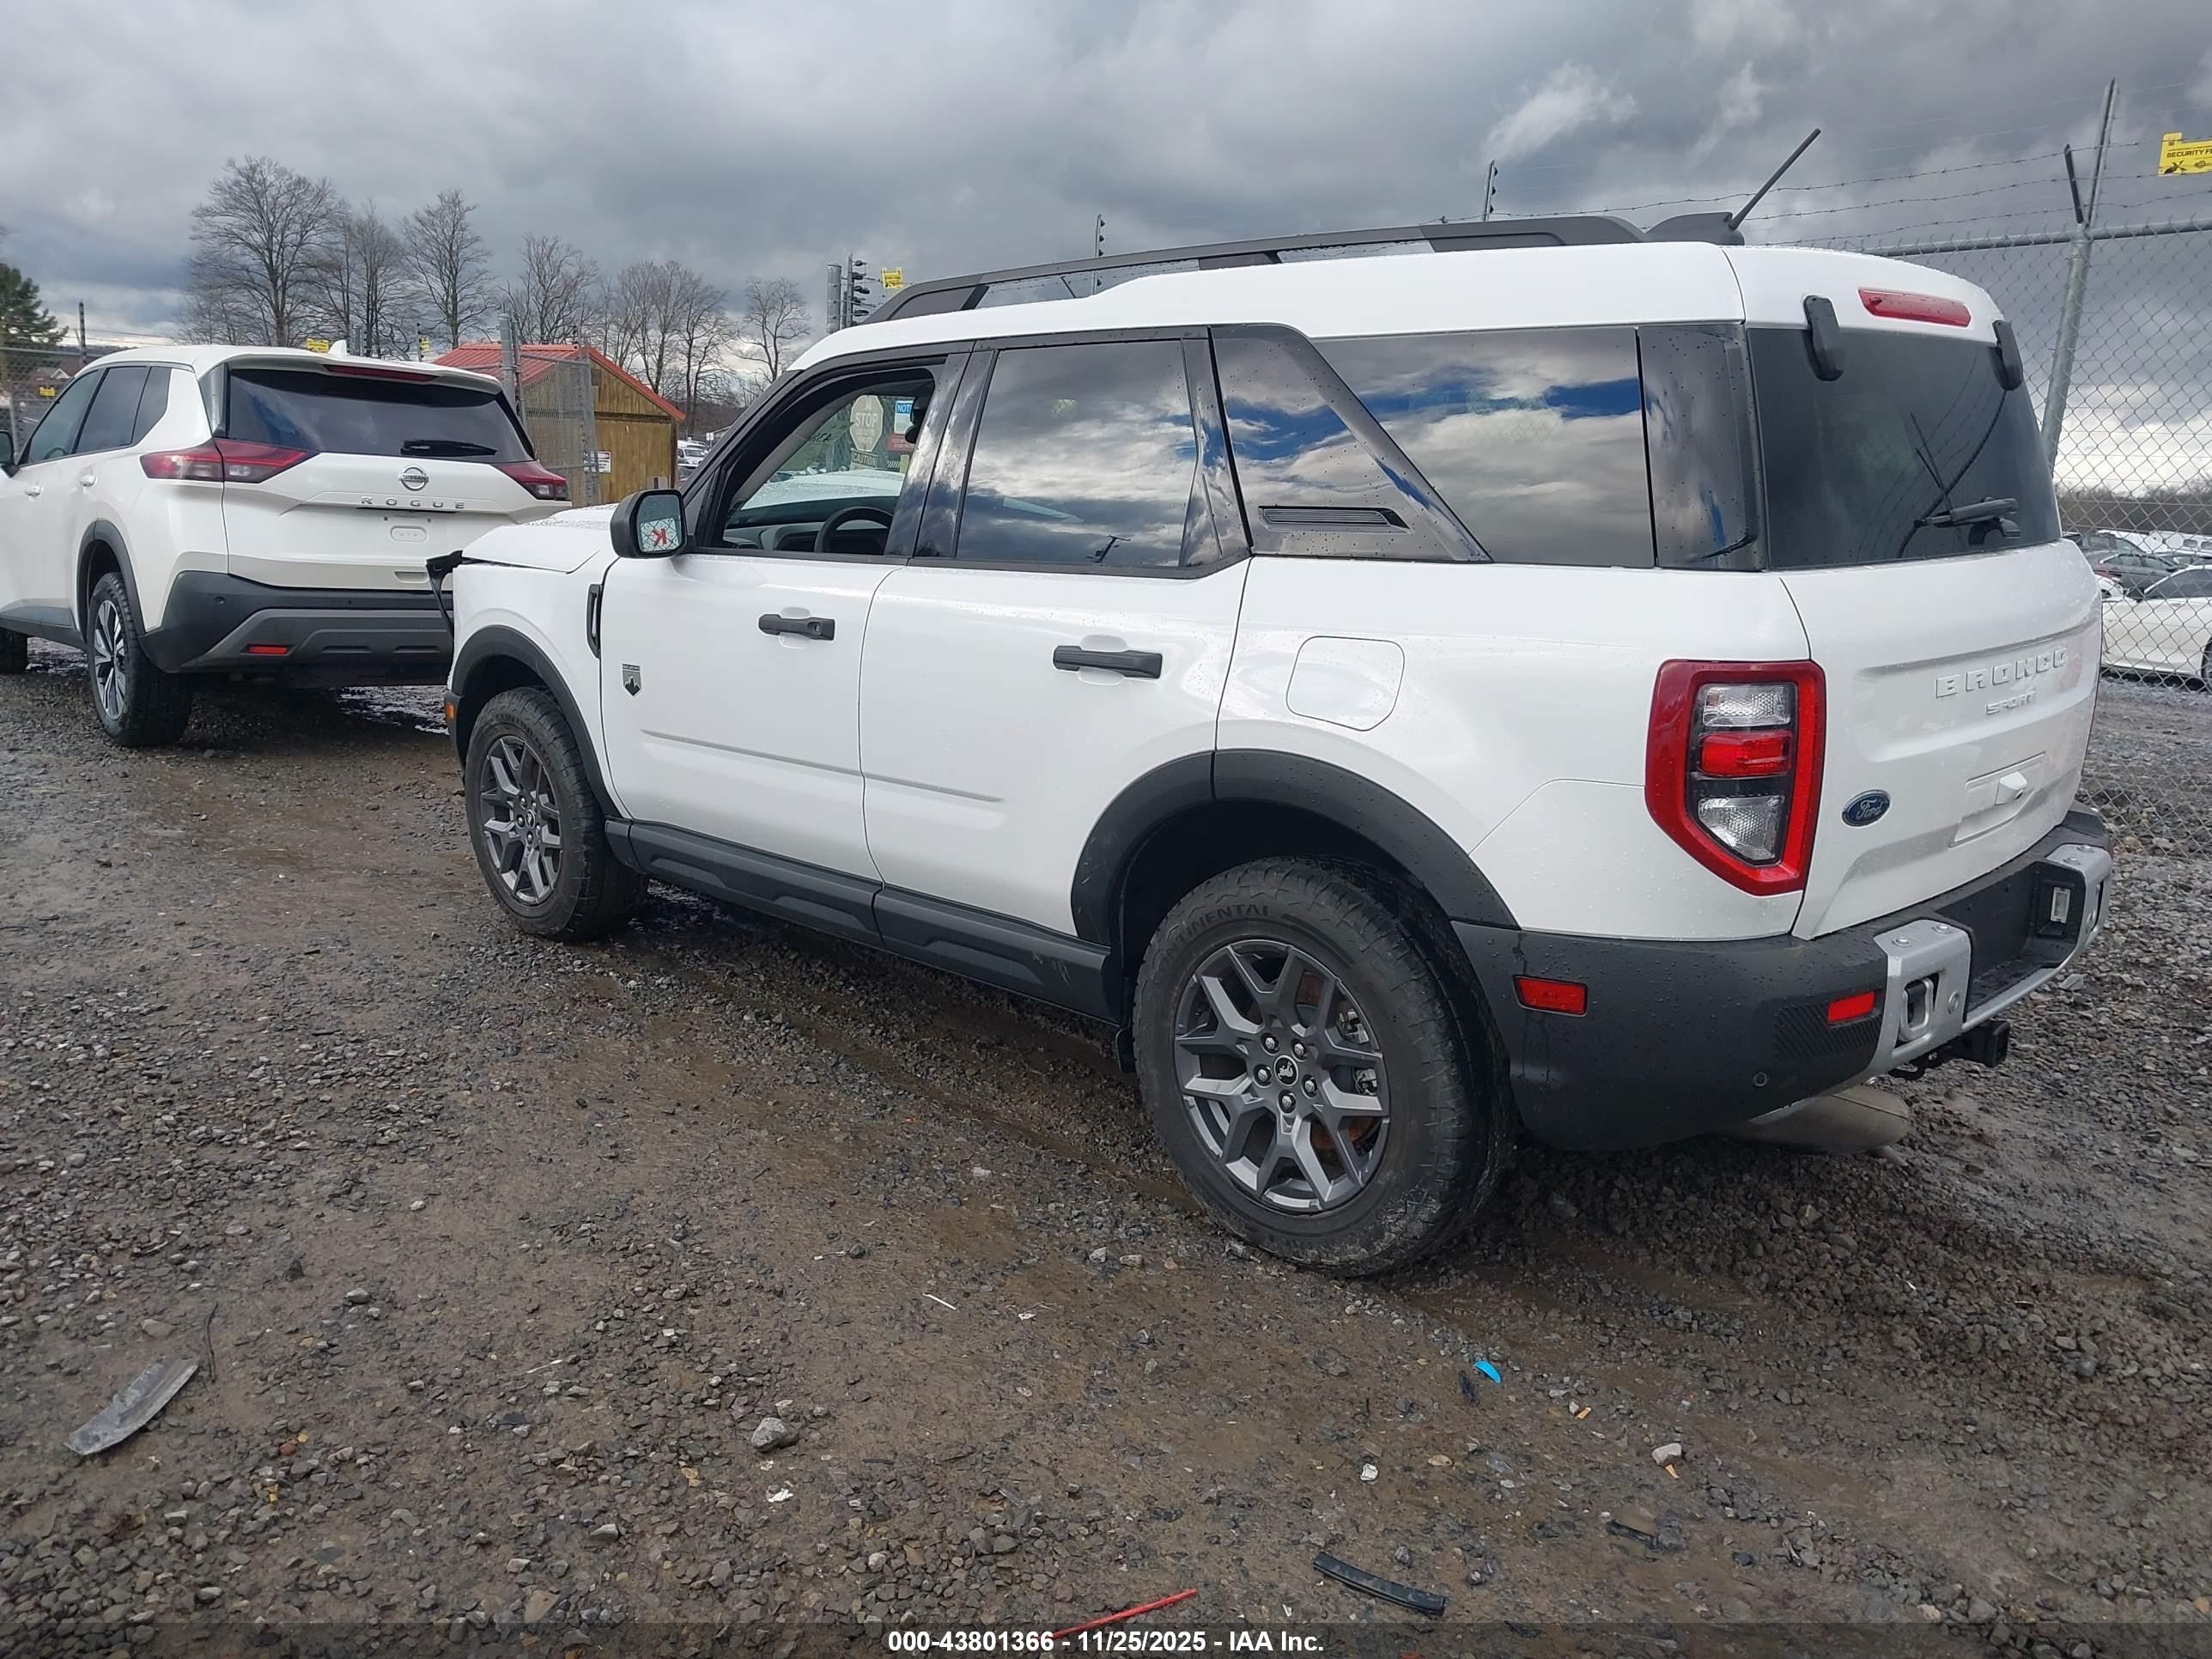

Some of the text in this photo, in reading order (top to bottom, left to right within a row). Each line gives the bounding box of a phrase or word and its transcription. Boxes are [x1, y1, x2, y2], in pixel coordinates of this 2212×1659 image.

[2166, 149, 2204, 158] SECURITY
[854, 412, 878, 428] STOP
[853, 453, 876, 467] CAUTION
[361, 496, 465, 508] ROGUE
[1936, 648, 2068, 698] BRONCO
[1985, 690, 2036, 714] SPORT
[1856, 799, 1883, 820] Ford
